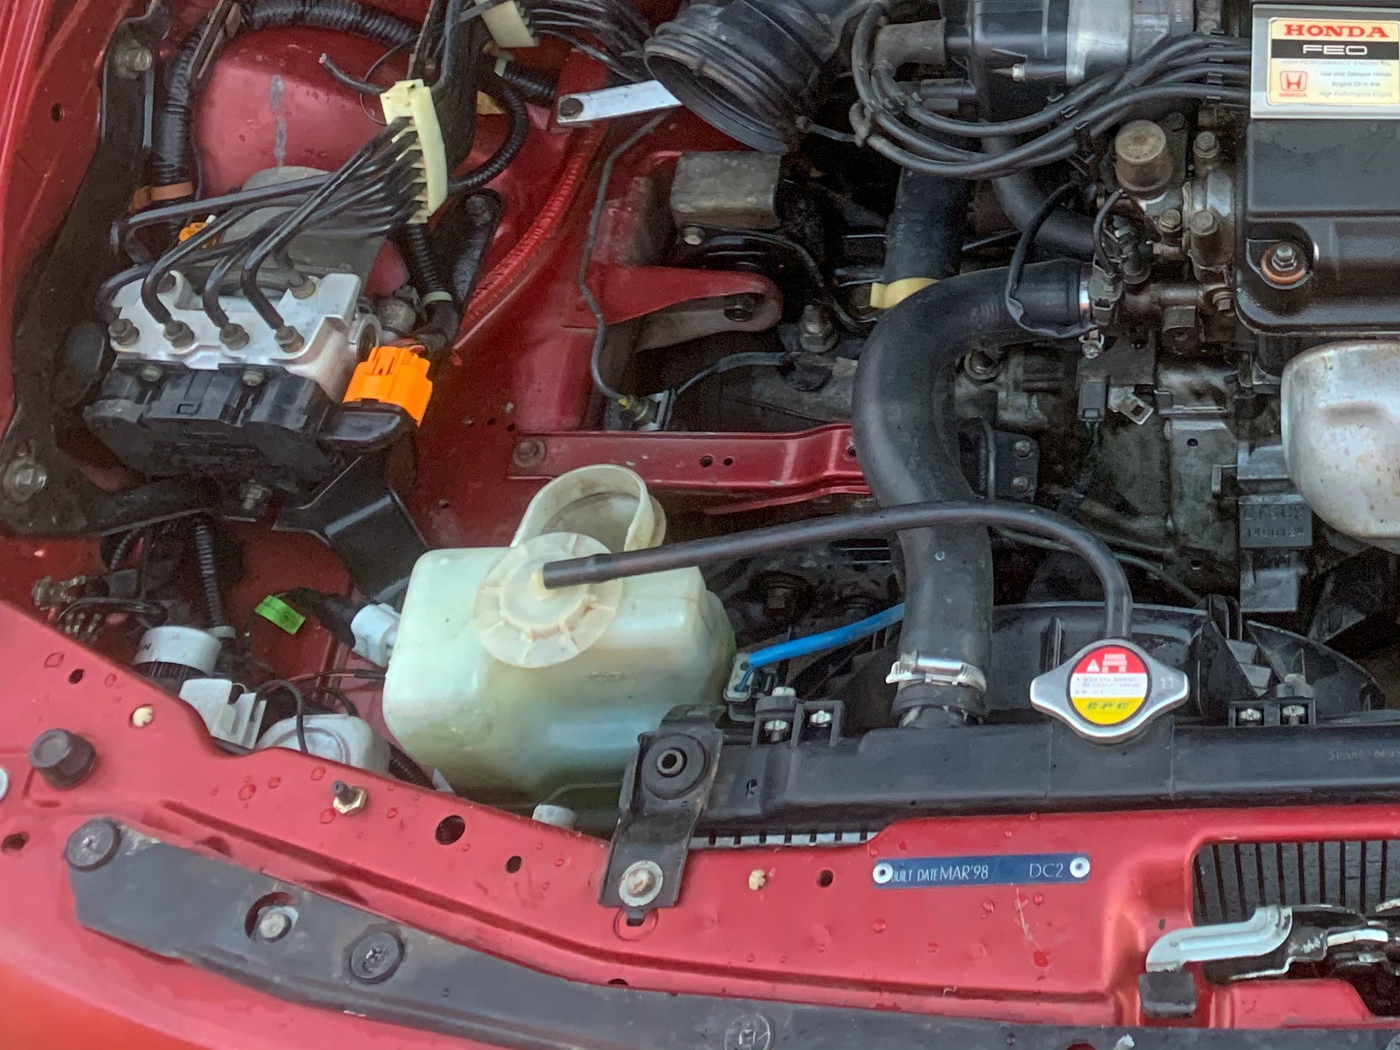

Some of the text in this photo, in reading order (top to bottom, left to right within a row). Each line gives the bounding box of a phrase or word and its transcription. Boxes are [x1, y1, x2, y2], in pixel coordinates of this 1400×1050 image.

[1283, 23, 1390, 38] HONDA
[1302, 44, 1368, 56] FEO
[917, 869, 939, 882] DATE
[940, 864, 989, 881] MAR'98
[1029, 862, 1064, 879] DC2
